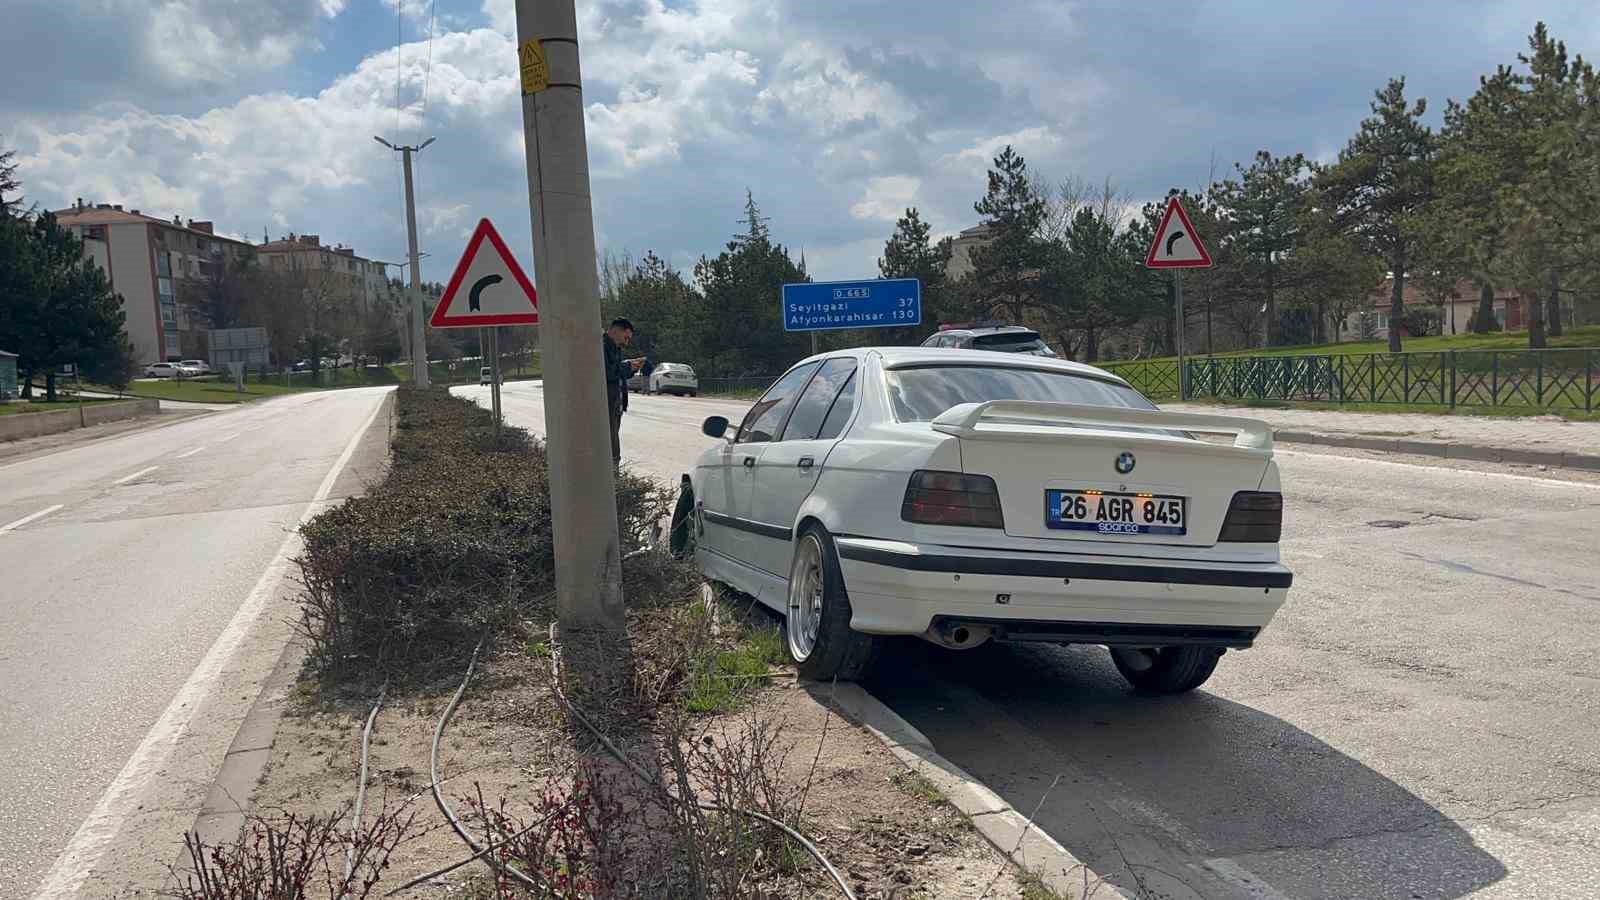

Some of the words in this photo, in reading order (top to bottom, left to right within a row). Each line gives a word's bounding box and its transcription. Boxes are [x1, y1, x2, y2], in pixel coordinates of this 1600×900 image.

[790, 303, 848, 313] Seyitgazi
[899, 298, 913, 307] 37
[791, 314, 884, 325] Afyonkarahisar
[892, 310, 914, 319] 130
[1061, 496, 1087, 520] 26
[1096, 497, 1134, 523] AGR
[1143, 501, 1181, 525] 845
